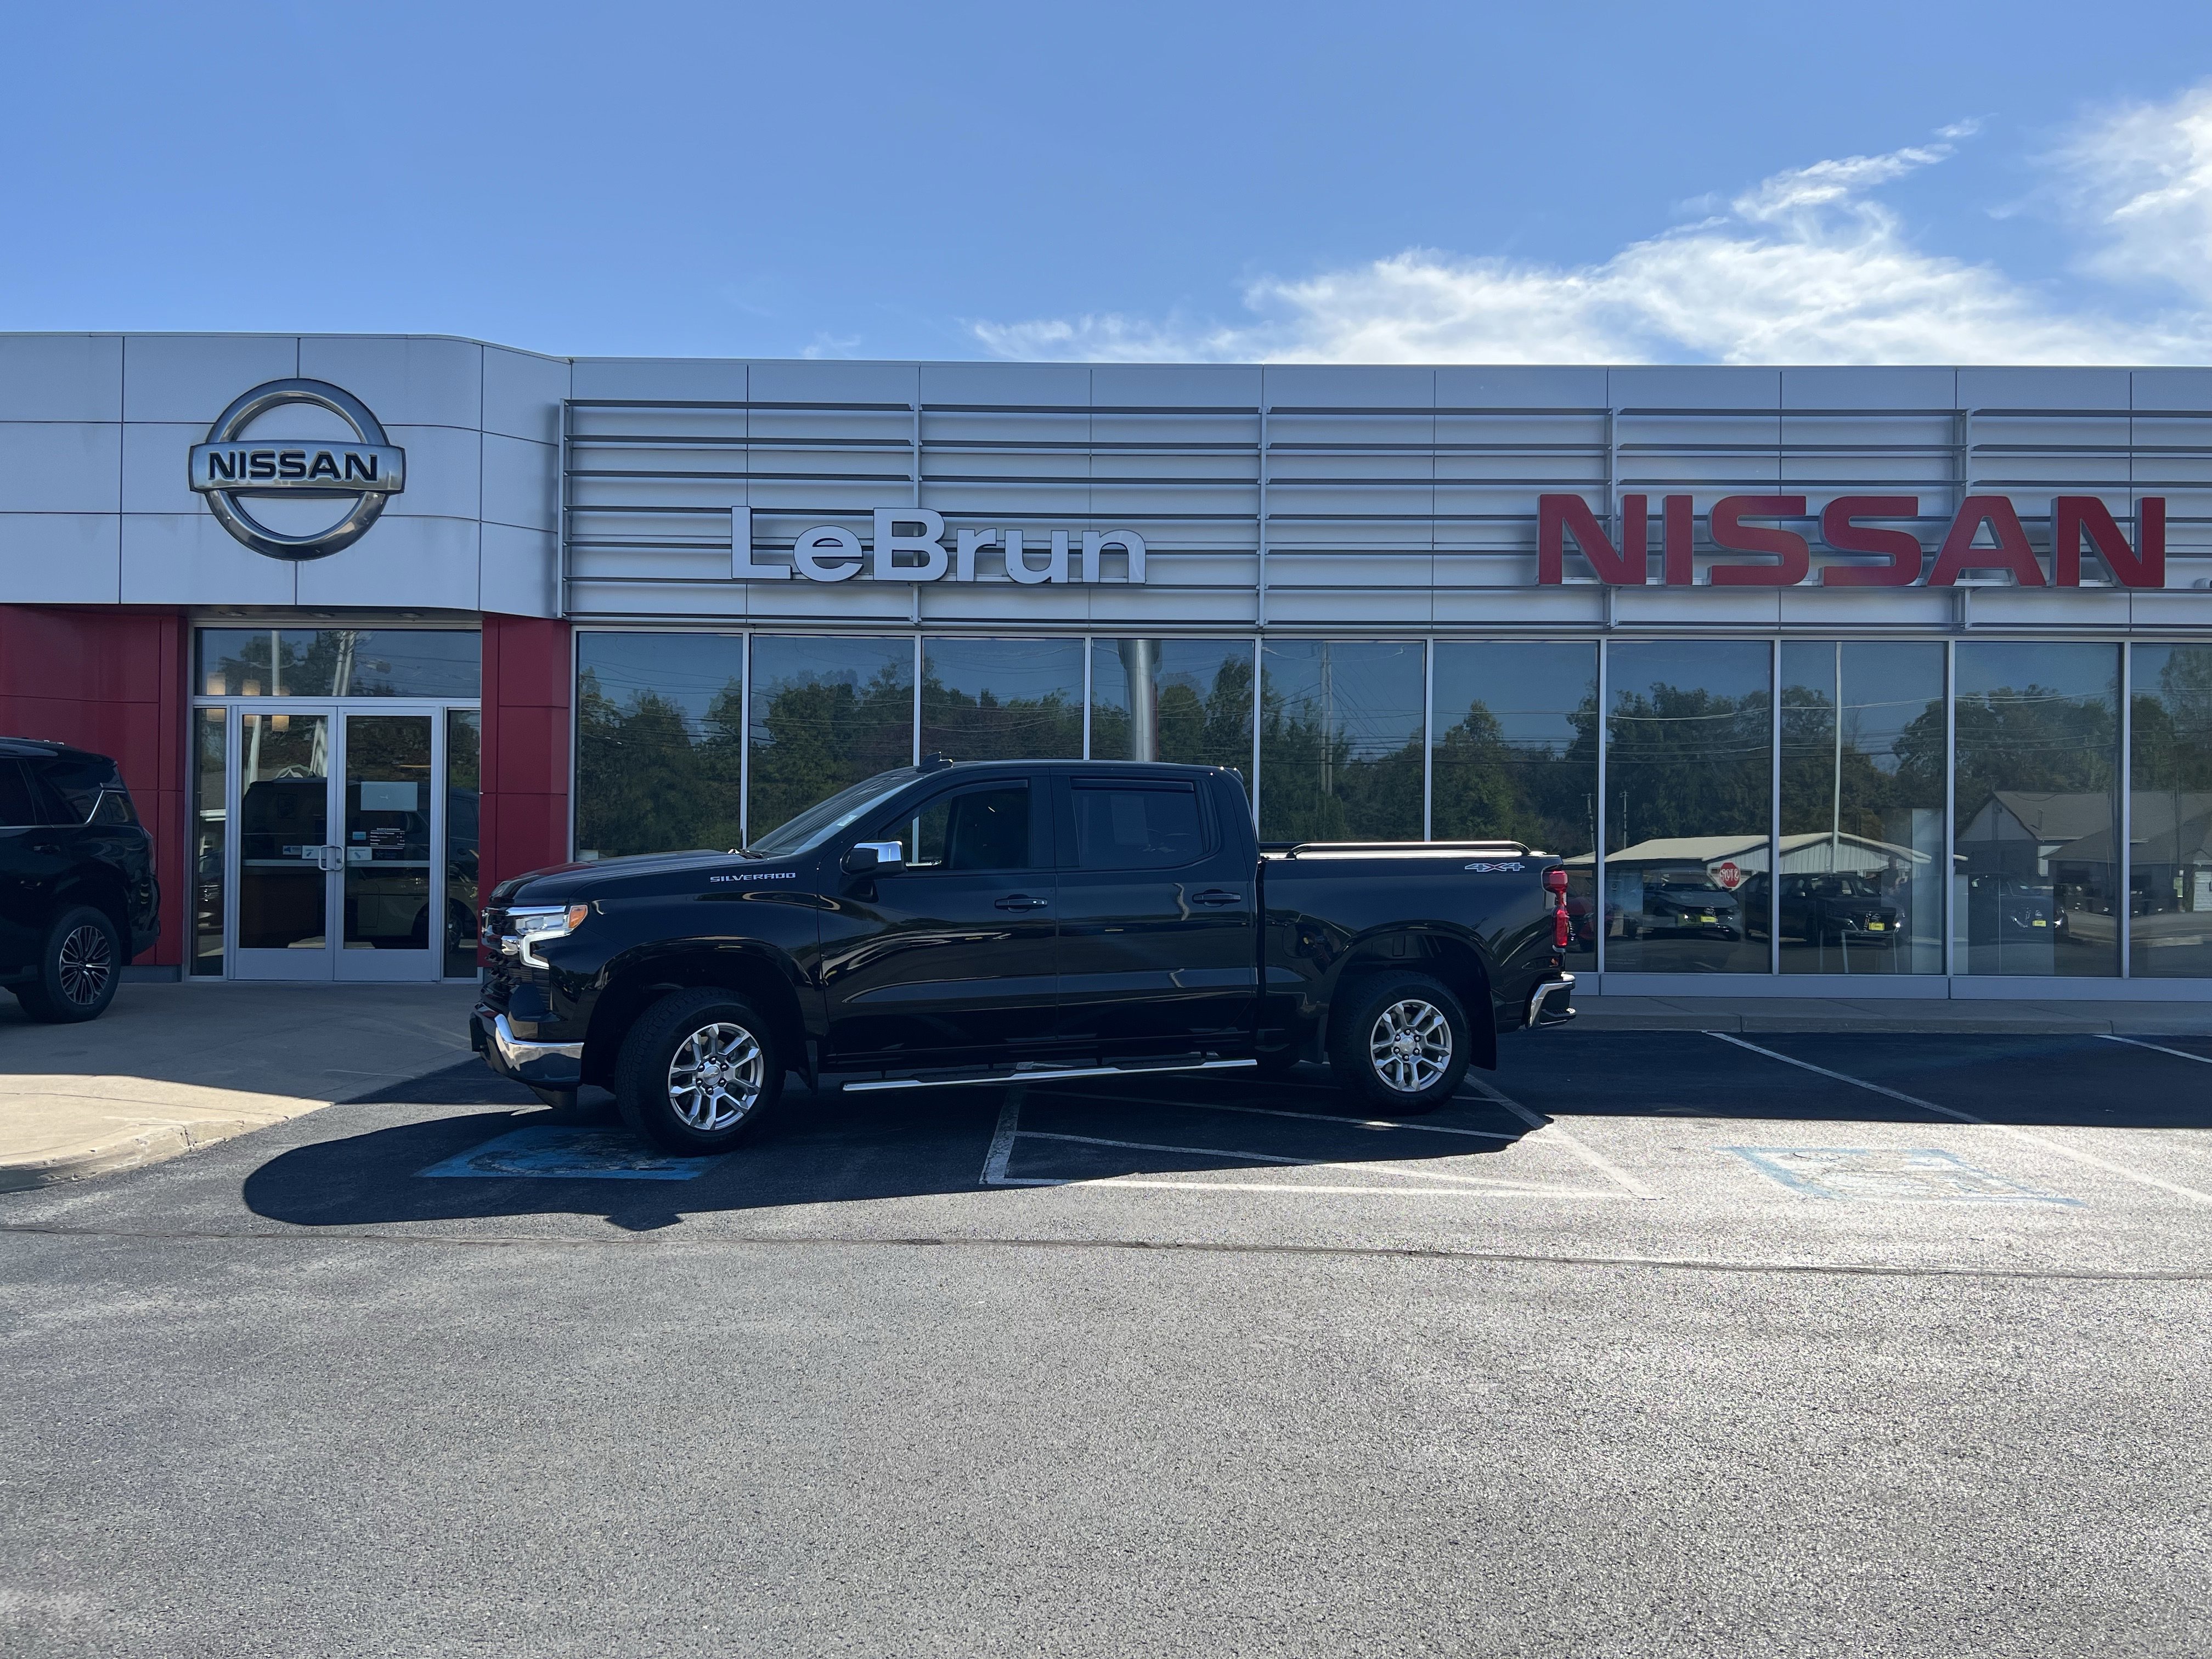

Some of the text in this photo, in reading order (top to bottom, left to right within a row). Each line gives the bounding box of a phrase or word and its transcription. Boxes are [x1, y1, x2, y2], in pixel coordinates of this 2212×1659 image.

[208, 450, 378, 481] NISSAN
[731, 506, 1147, 584] LeBrun
[1538, 494, 2166, 589] NISSAN
[710, 872, 795, 882] SILVERADO
